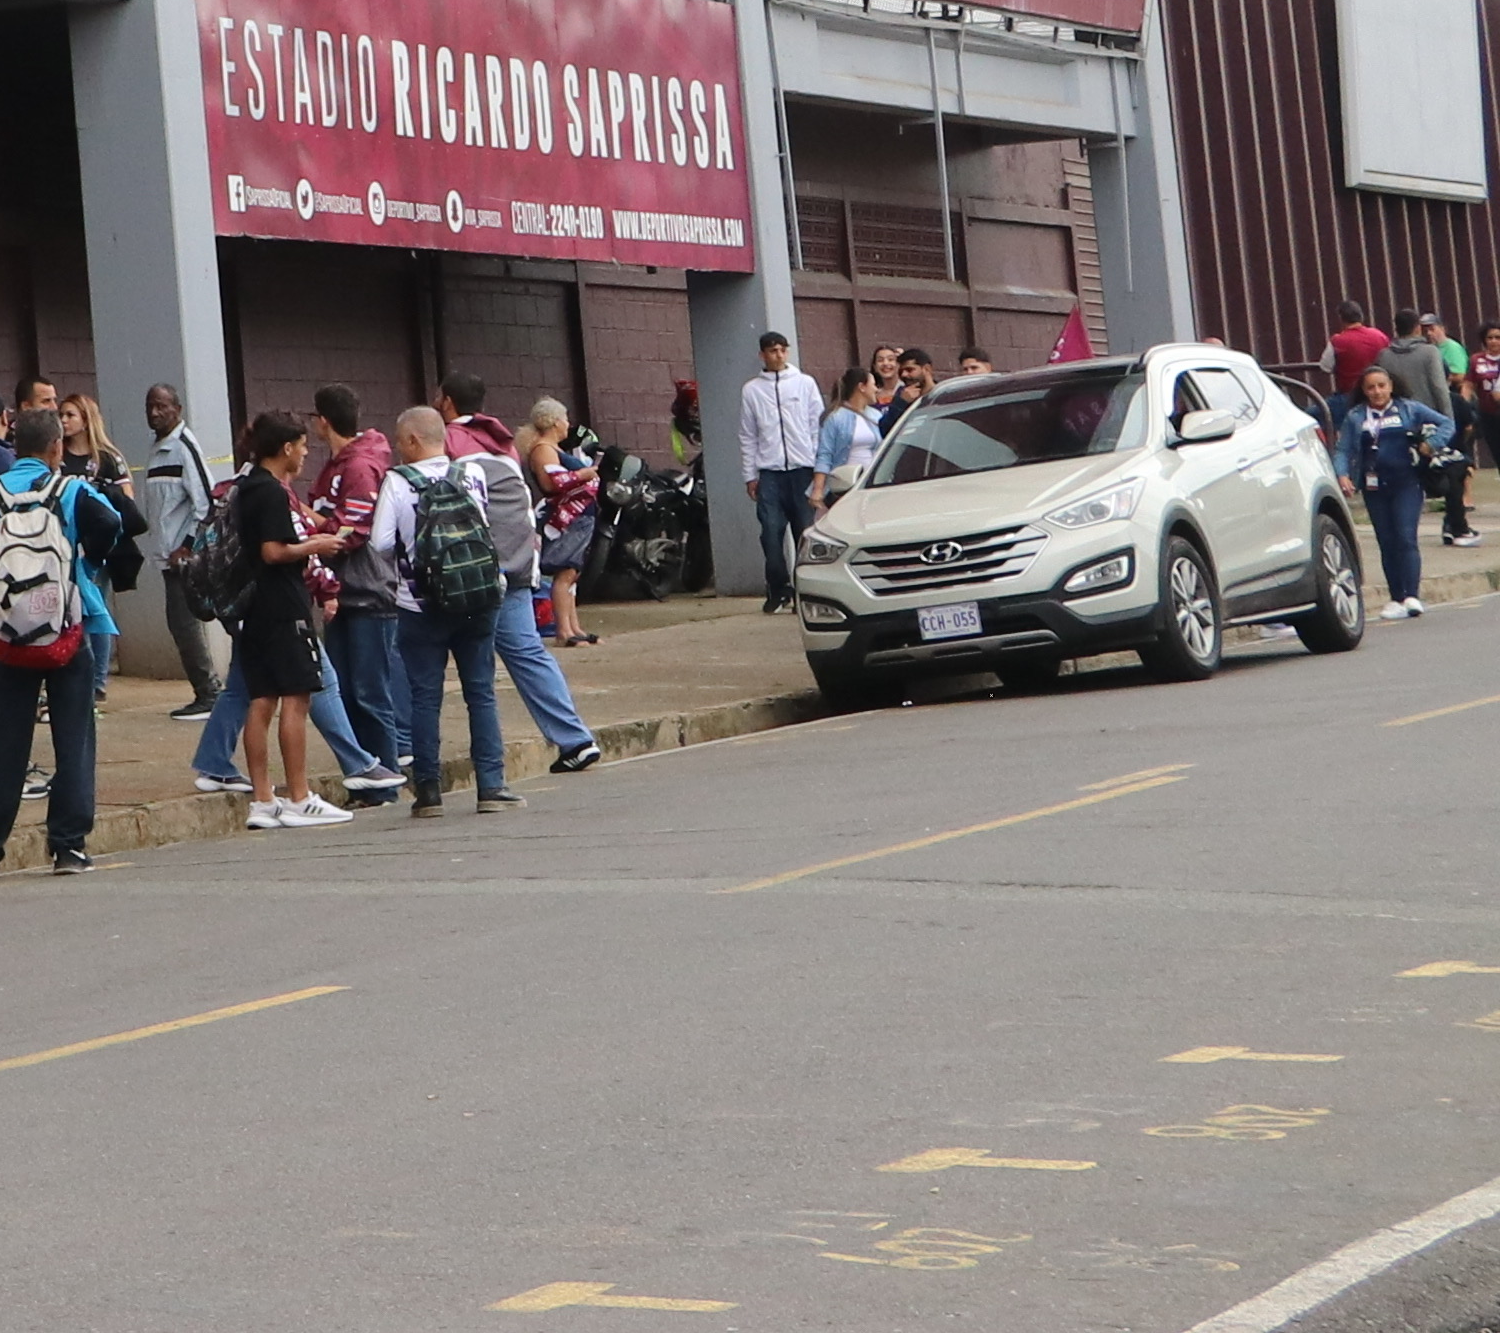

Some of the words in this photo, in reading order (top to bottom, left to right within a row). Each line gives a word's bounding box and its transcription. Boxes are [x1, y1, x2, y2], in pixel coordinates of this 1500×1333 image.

[218, 16, 378, 133] ESTADIO
[391, 39, 553, 154] RICARDO
[563, 63, 735, 170] SAPRISSA
[921, 610, 977, 632] CCH-055
